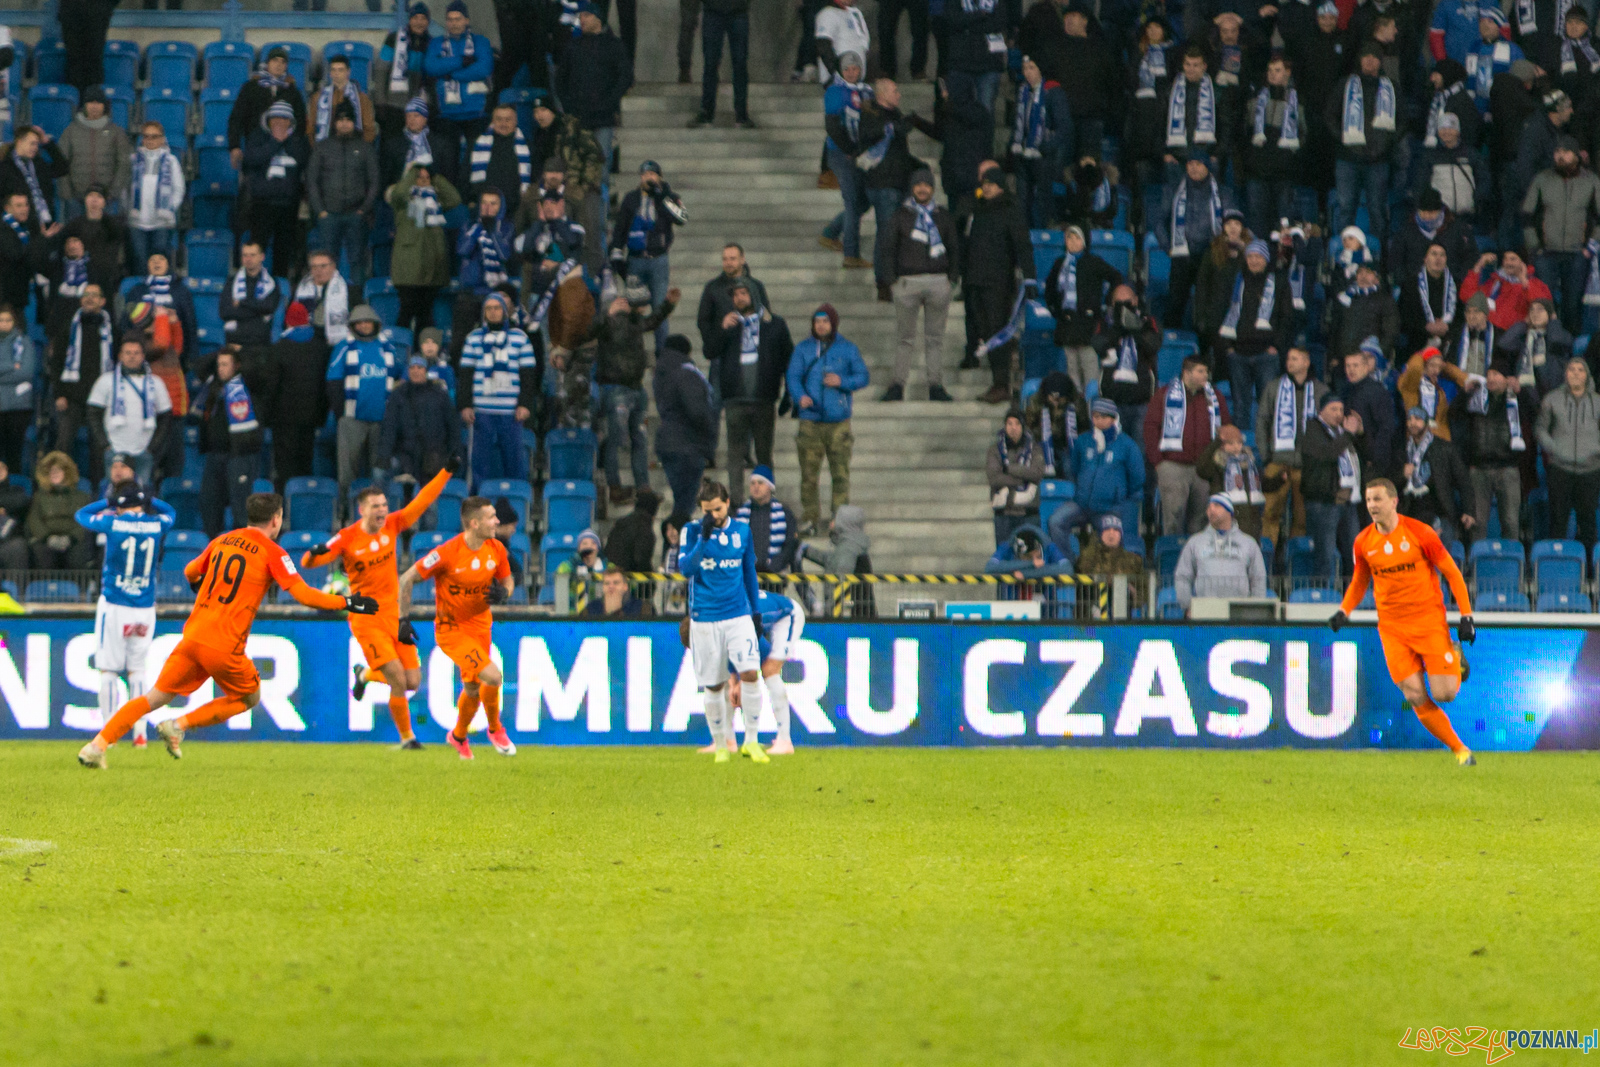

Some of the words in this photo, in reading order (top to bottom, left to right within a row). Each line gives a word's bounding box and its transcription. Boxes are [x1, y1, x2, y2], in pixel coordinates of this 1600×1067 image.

[121, 535, 155, 577] 11
[211, 550, 247, 605] 19
[368, 643, 381, 659] 2
[464, 649, 483, 669] 37
[963, 638, 1358, 738] CZASU
